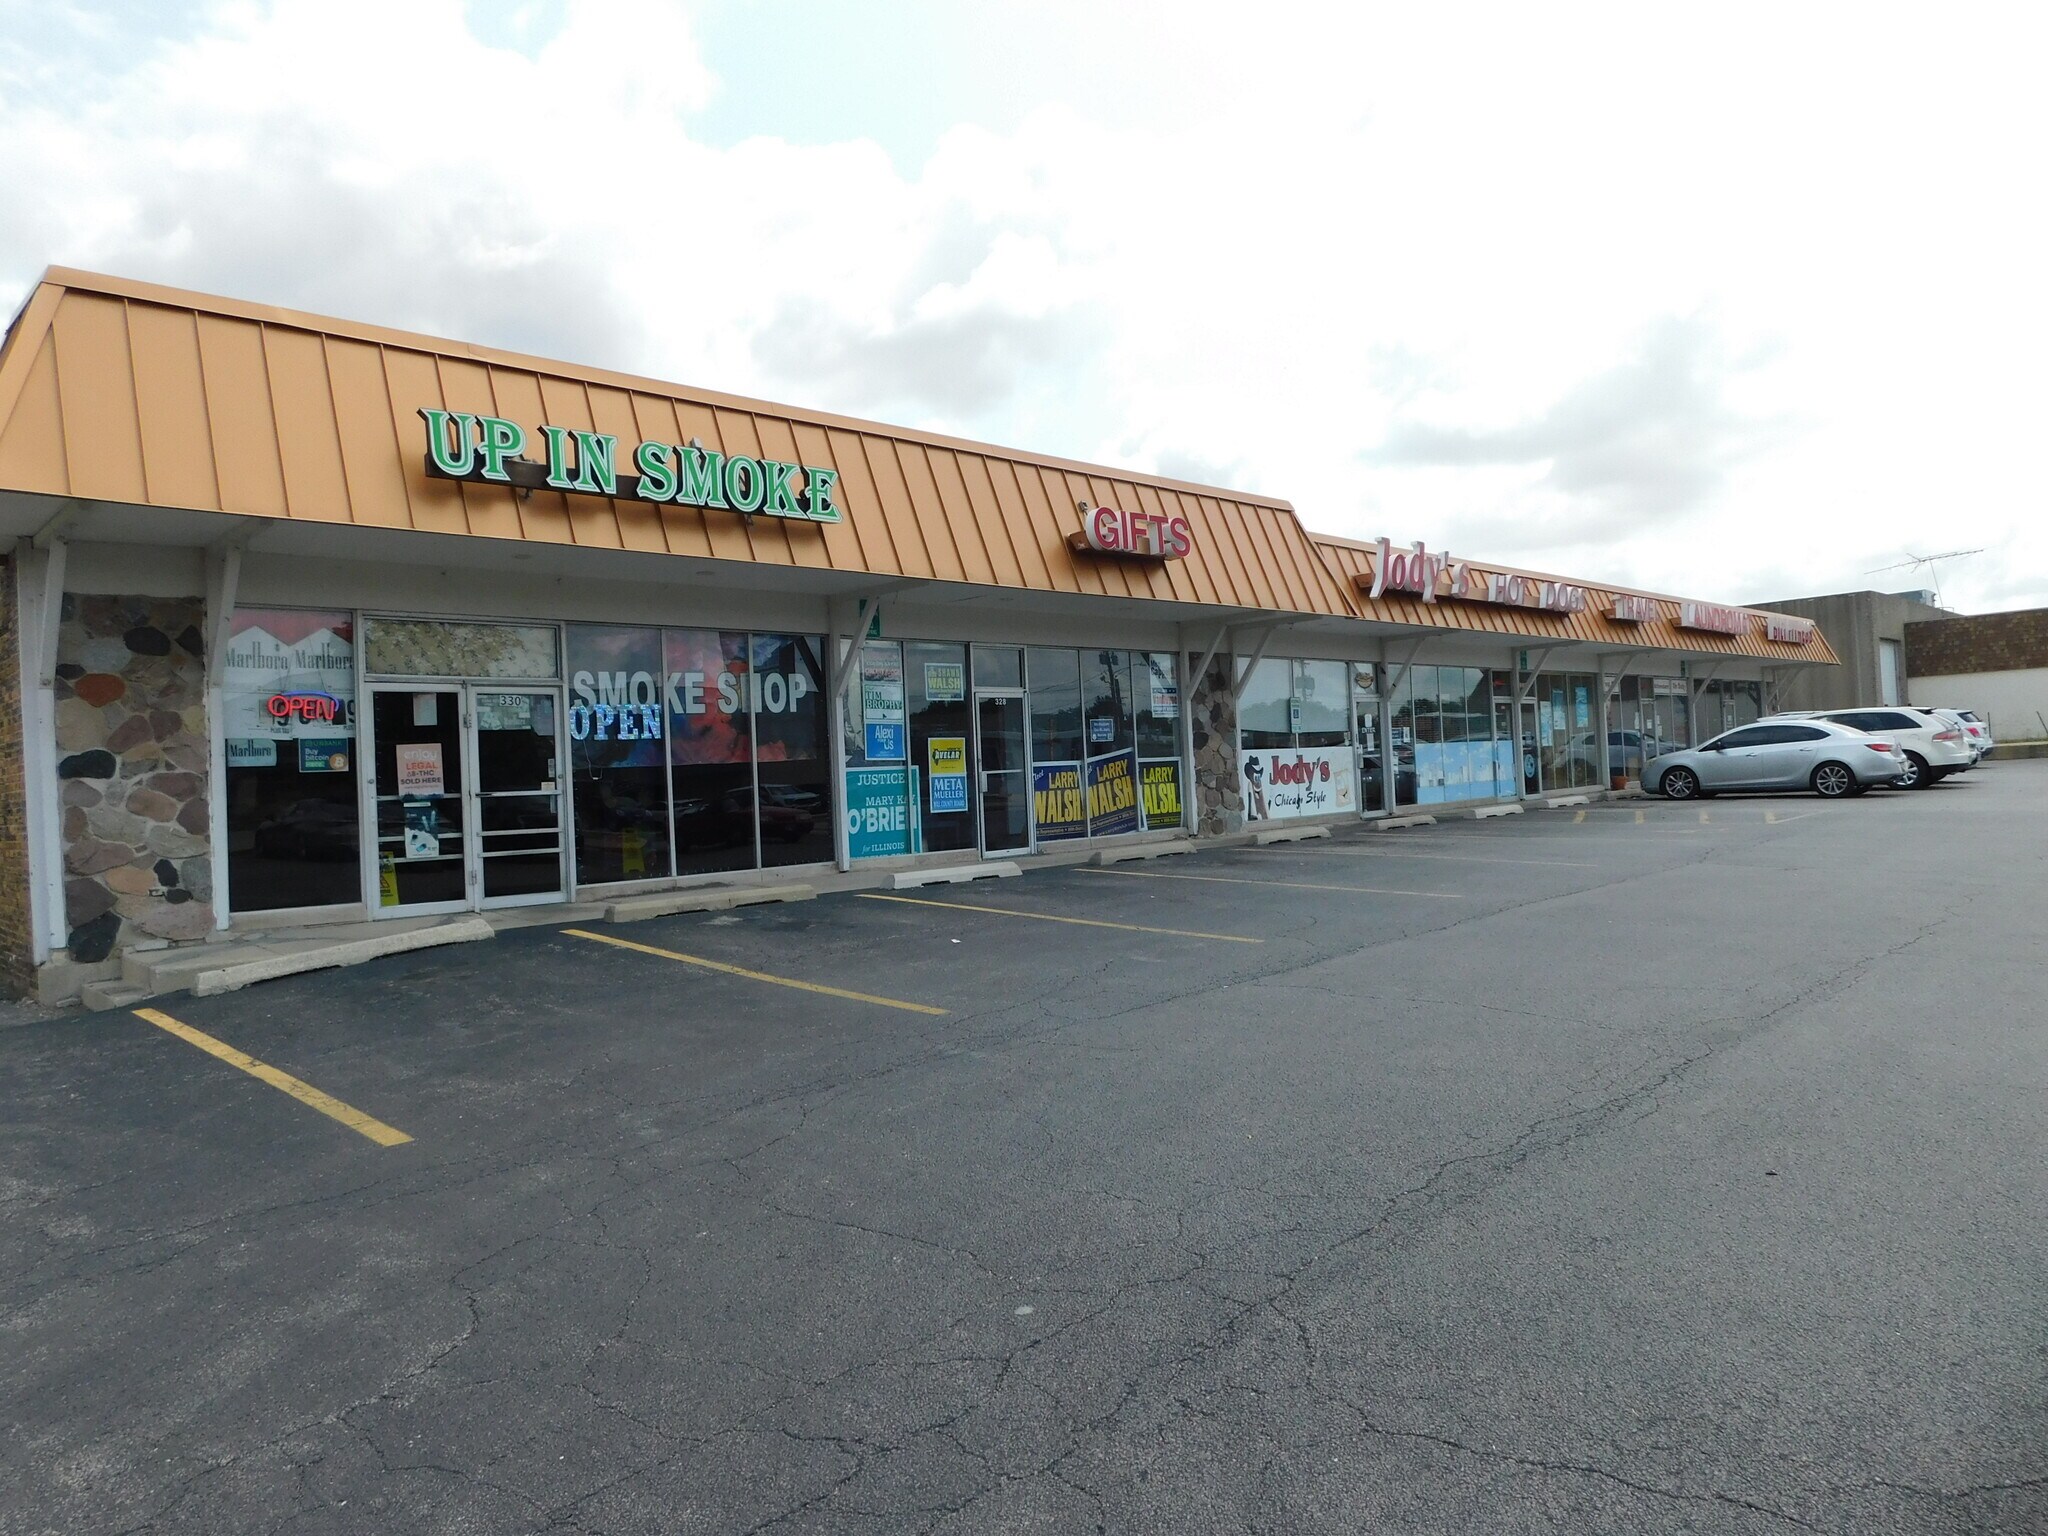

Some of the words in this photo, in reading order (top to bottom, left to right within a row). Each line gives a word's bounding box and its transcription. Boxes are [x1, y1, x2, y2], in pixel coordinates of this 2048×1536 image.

[417, 407, 527, 481] UP
[538, 423, 618, 495] IN
[633, 437, 842, 523] SMOKE
[1086, 506, 1191, 558] GIFTS
[1369, 536, 1470, 604] Jody's
[1488, 574, 1528, 607] HOT
[928, 677, 961, 689] WALSH
[573, 670, 706, 714] SMOKE
[717, 672, 807, 714] SHOP
[865, 691, 882, 701] TIM
[268, 695, 335, 720] OPEN
[500, 695, 521, 706] 330
[866, 700, 901, 710] BROPHY
[994, 698, 1007, 706] 328
[569, 703, 662, 741] OPEN
[875, 725, 894, 739] Alexi
[230, 740, 272, 757] Marlboro
[406, 762, 437, 770] LEGAL
[1096, 759, 1128, 782] LARRY
[1269, 755, 1331, 791] Jody's
[857, 773, 906, 786] JUSTICE
[1049, 771, 1080, 789] LARRY
[1143, 767, 1174, 783] LARRY
[934, 778, 964, 791] META
[865, 795, 894, 806] MARY
[934, 790, 964, 799] MUELLER
[1305, 791, 1327, 809] Style
[871, 842, 905, 852] ILLINOIS
